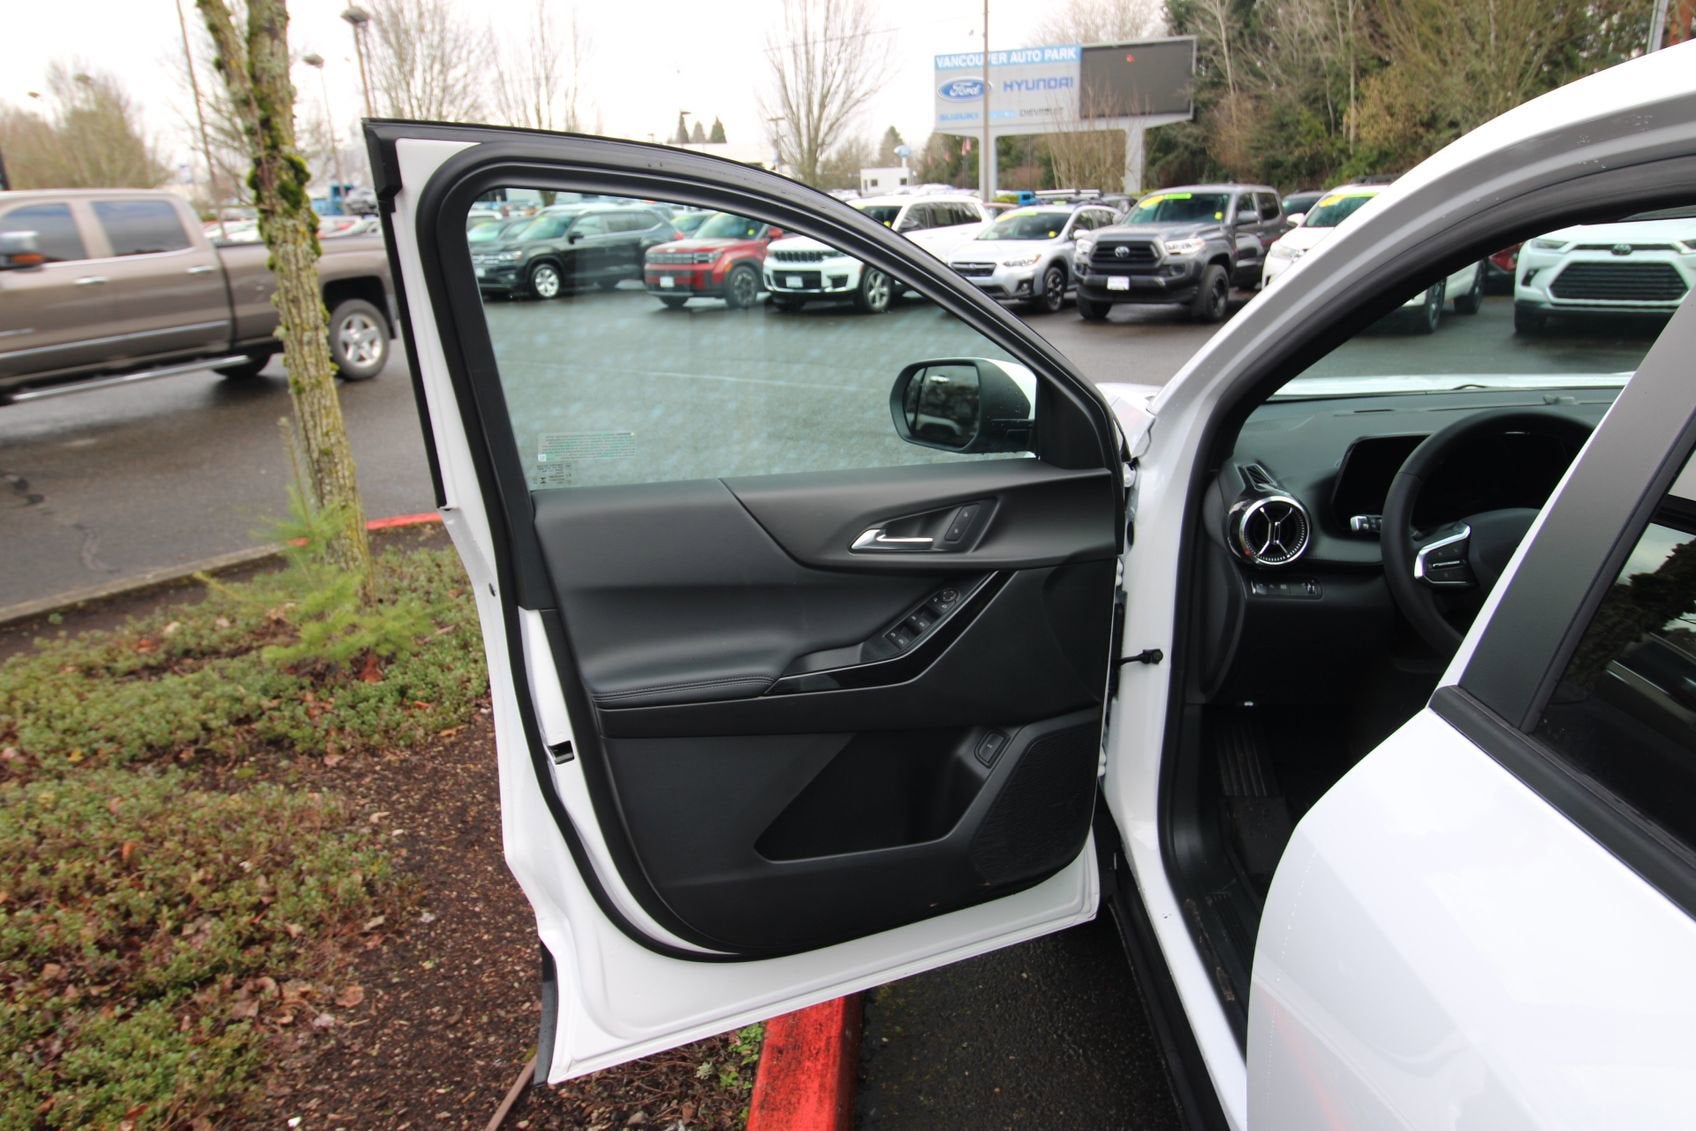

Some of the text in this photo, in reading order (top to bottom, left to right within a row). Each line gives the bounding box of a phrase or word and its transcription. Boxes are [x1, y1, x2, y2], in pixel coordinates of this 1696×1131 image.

[1010, 49, 1042, 63] AUTO
[1044, 47, 1076, 60] PARK
[949, 82, 981, 96] Ford
[1003, 77, 1073, 92] HYUNDAI
